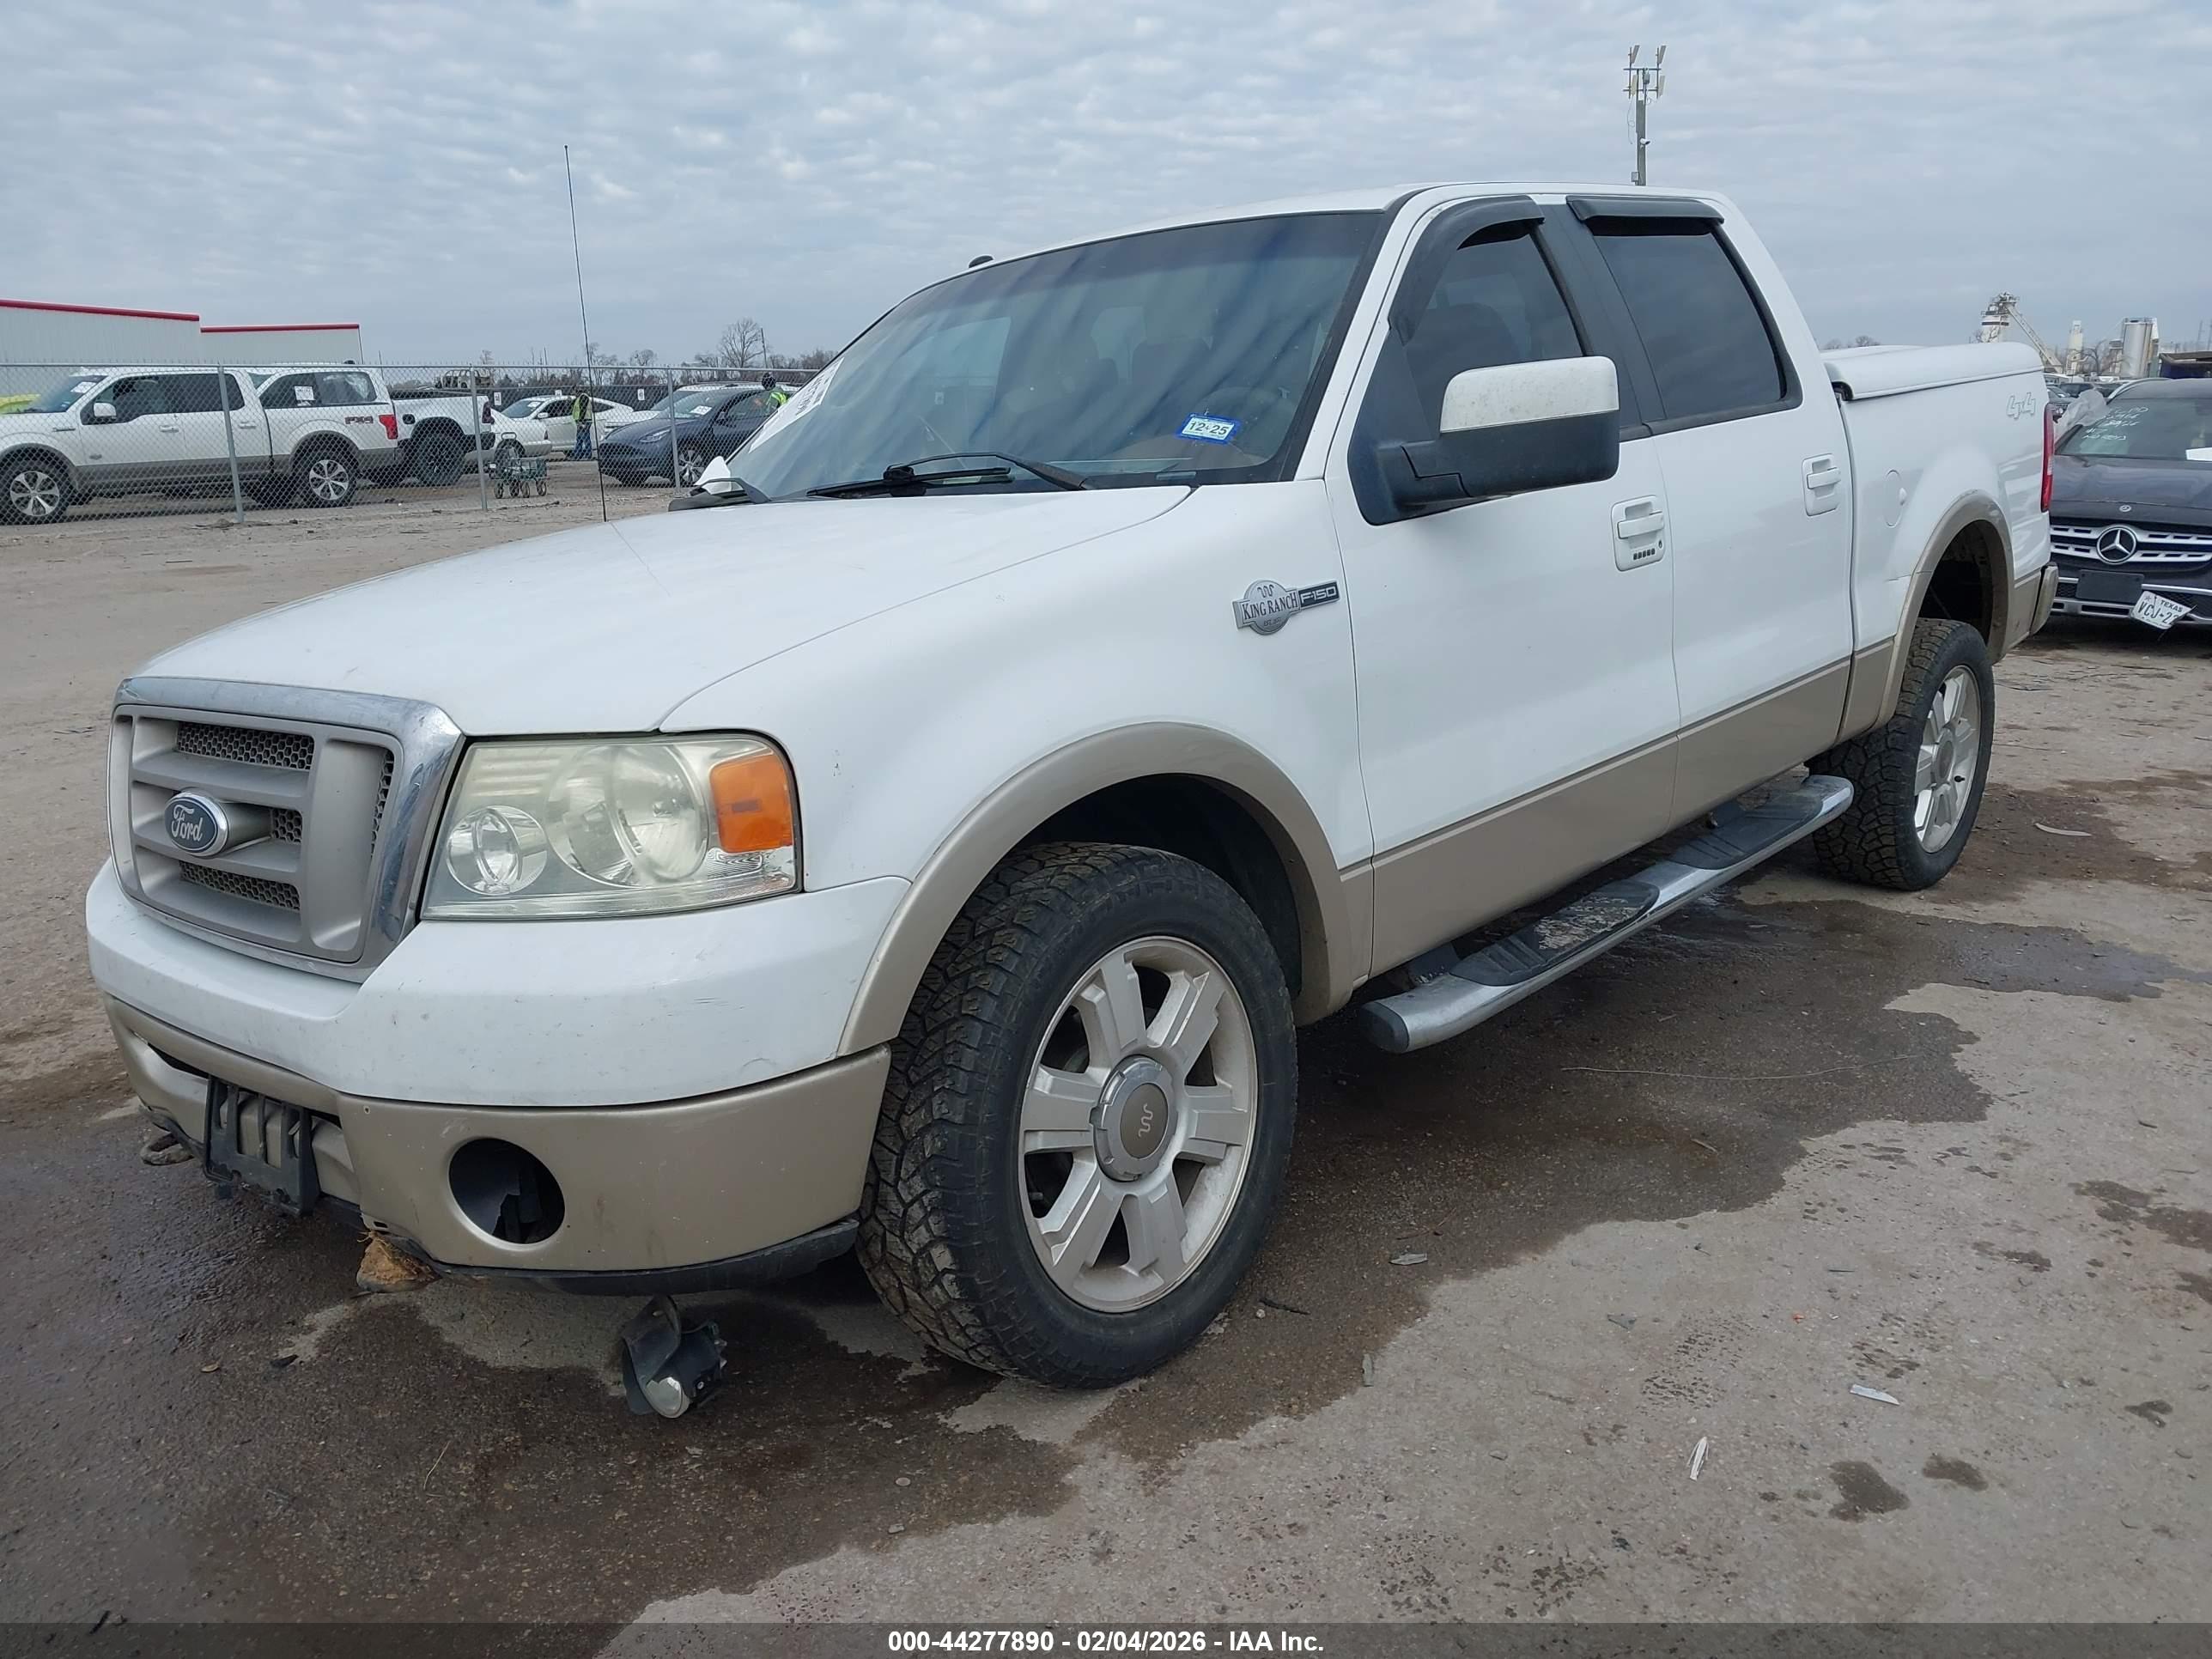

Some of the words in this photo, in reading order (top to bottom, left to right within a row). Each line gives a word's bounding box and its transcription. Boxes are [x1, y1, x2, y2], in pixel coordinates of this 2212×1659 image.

[1242, 602, 1267, 620] KING
[1268, 590, 1298, 614] RANCH
[1300, 586, 1337, 604] F-150
[2160, 599, 2184, 613] TEXAS
[171, 804, 204, 842] Ford
